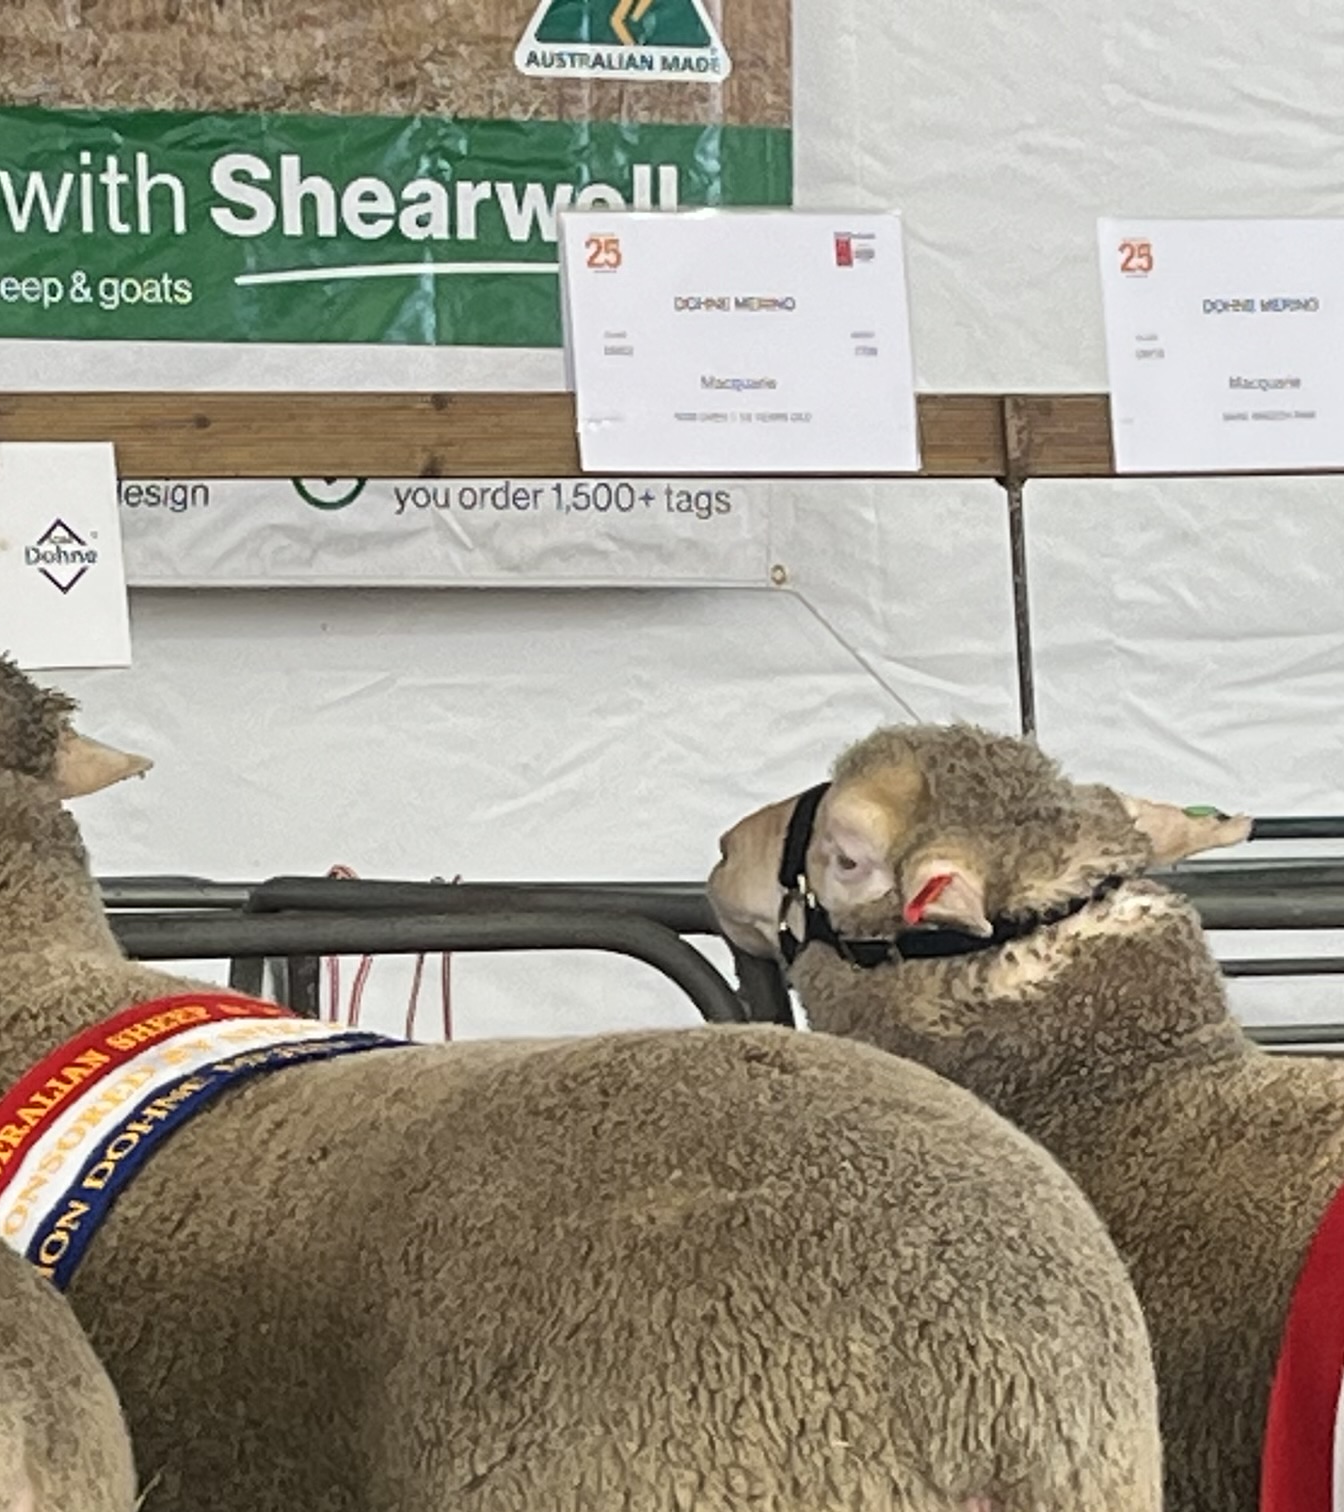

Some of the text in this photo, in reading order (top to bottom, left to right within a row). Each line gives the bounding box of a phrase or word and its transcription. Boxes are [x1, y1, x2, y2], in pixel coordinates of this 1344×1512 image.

[525, 50, 720, 73] AUSTRALIAN MADE
[585, 237, 622, 268] 25
[1118, 243, 1153, 272] 25
[70, 271, 93, 303] &
[99, 272, 193, 309] goats
[394, 484, 450, 515] you
[458, 483, 544, 512] order
[550, 483, 656, 514] 1,500+
[664, 483, 732, 517] tags
[24, 546, 98, 565] Dohne
